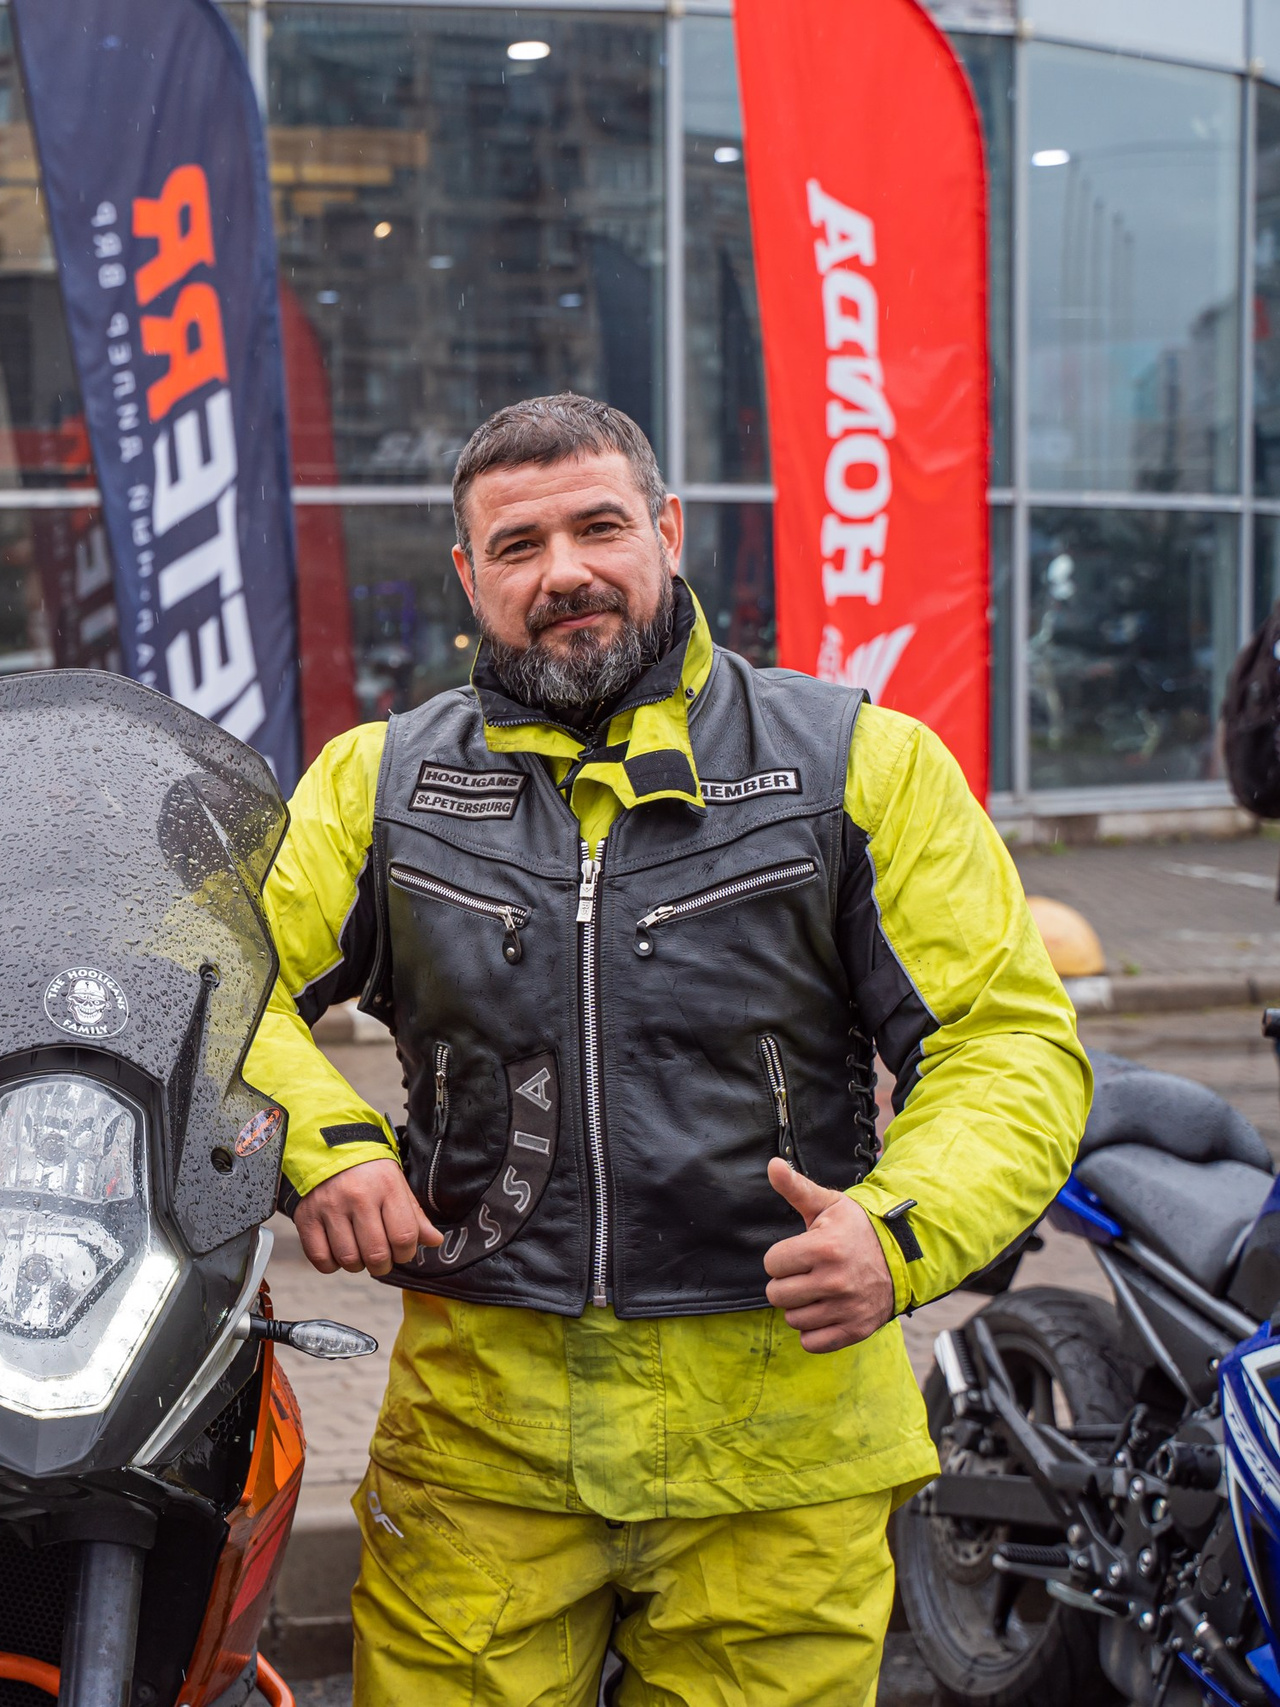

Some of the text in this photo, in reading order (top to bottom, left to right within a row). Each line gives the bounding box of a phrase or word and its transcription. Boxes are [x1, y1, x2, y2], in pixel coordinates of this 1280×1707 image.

[425, 770, 519, 788] HOOLIGANS
[416, 794, 512, 814] St.PETERSBURG
[47, 969, 126, 1010] THE HOOLIGANS
[62, 1019, 108, 1035] FAMILY
[414, 1067, 552, 1266] USSIA
